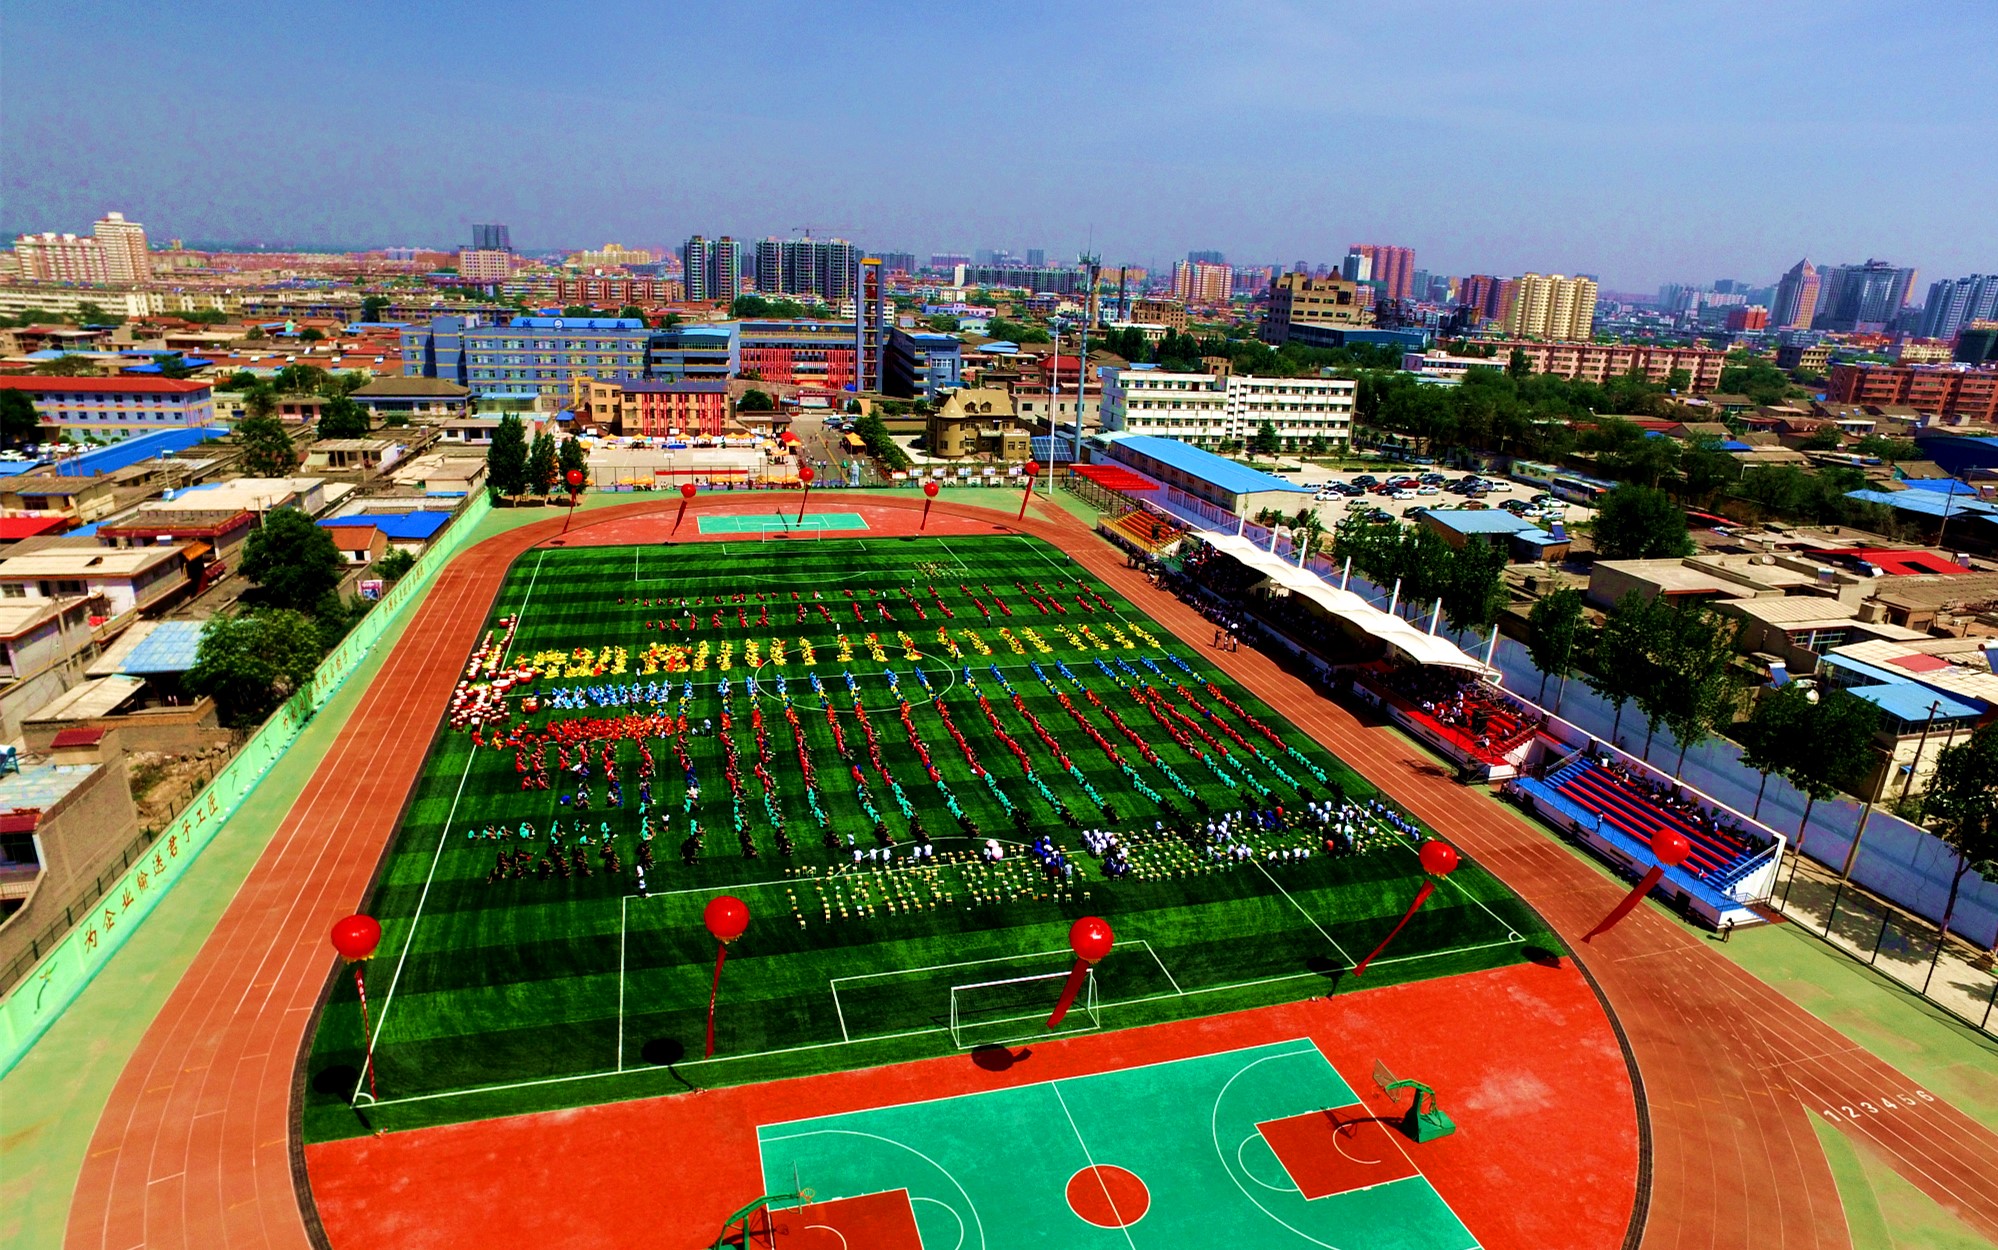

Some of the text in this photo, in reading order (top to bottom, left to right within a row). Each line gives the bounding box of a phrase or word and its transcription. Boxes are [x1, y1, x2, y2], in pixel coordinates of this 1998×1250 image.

[84, 790, 218, 954] 为企业输送君子工匠
